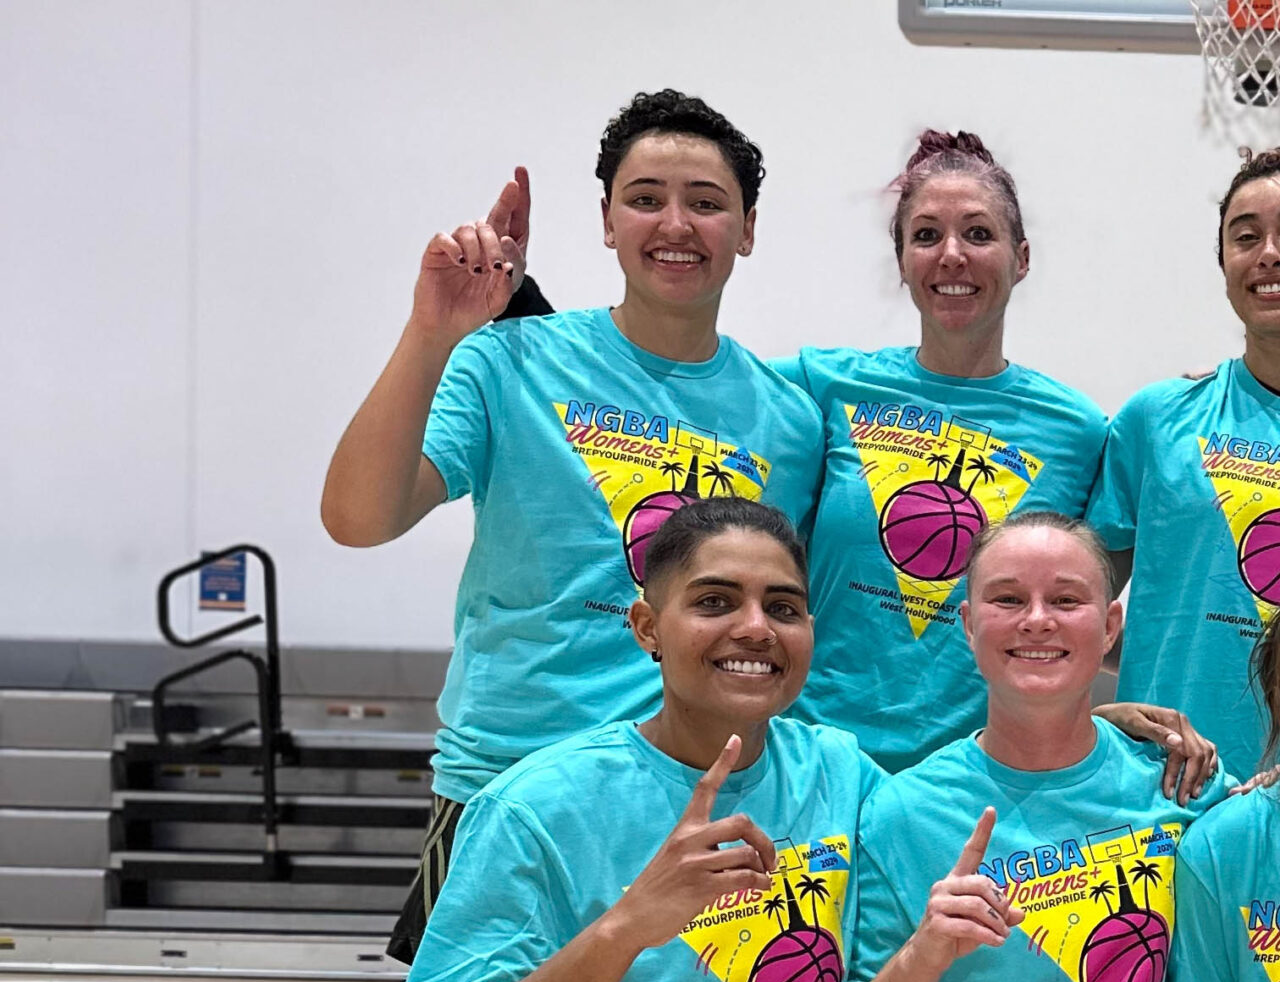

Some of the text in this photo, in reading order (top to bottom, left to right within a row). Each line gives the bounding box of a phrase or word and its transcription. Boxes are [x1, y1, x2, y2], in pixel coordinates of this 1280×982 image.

[564, 400, 669, 444] NGBA
[851, 401, 943, 437] NGBA
[572, 446, 658, 469] #REPYOURPRIDE
[720, 448, 749, 463] MARCH
[852, 442, 926, 460] #REPYOURPRIDE
[989, 443, 1018, 462] MARCH
[736, 461, 755, 476] 2024
[1002, 458, 1022, 472] 2024
[1204, 471, 1278, 489] #REPYOURPRIDE
[848, 581, 898, 600] INAUGURAL
[900, 593, 926, 606] WEST
[927, 599, 956, 614] COAST
[584, 600, 630, 616] INAUGUR
[880, 600, 956, 626] West Hollywood
[1206, 612, 1258, 628] INAUGURAL
[977, 839, 1087, 888] NGBA
[680, 905, 761, 934] EPYOURPRIDE
